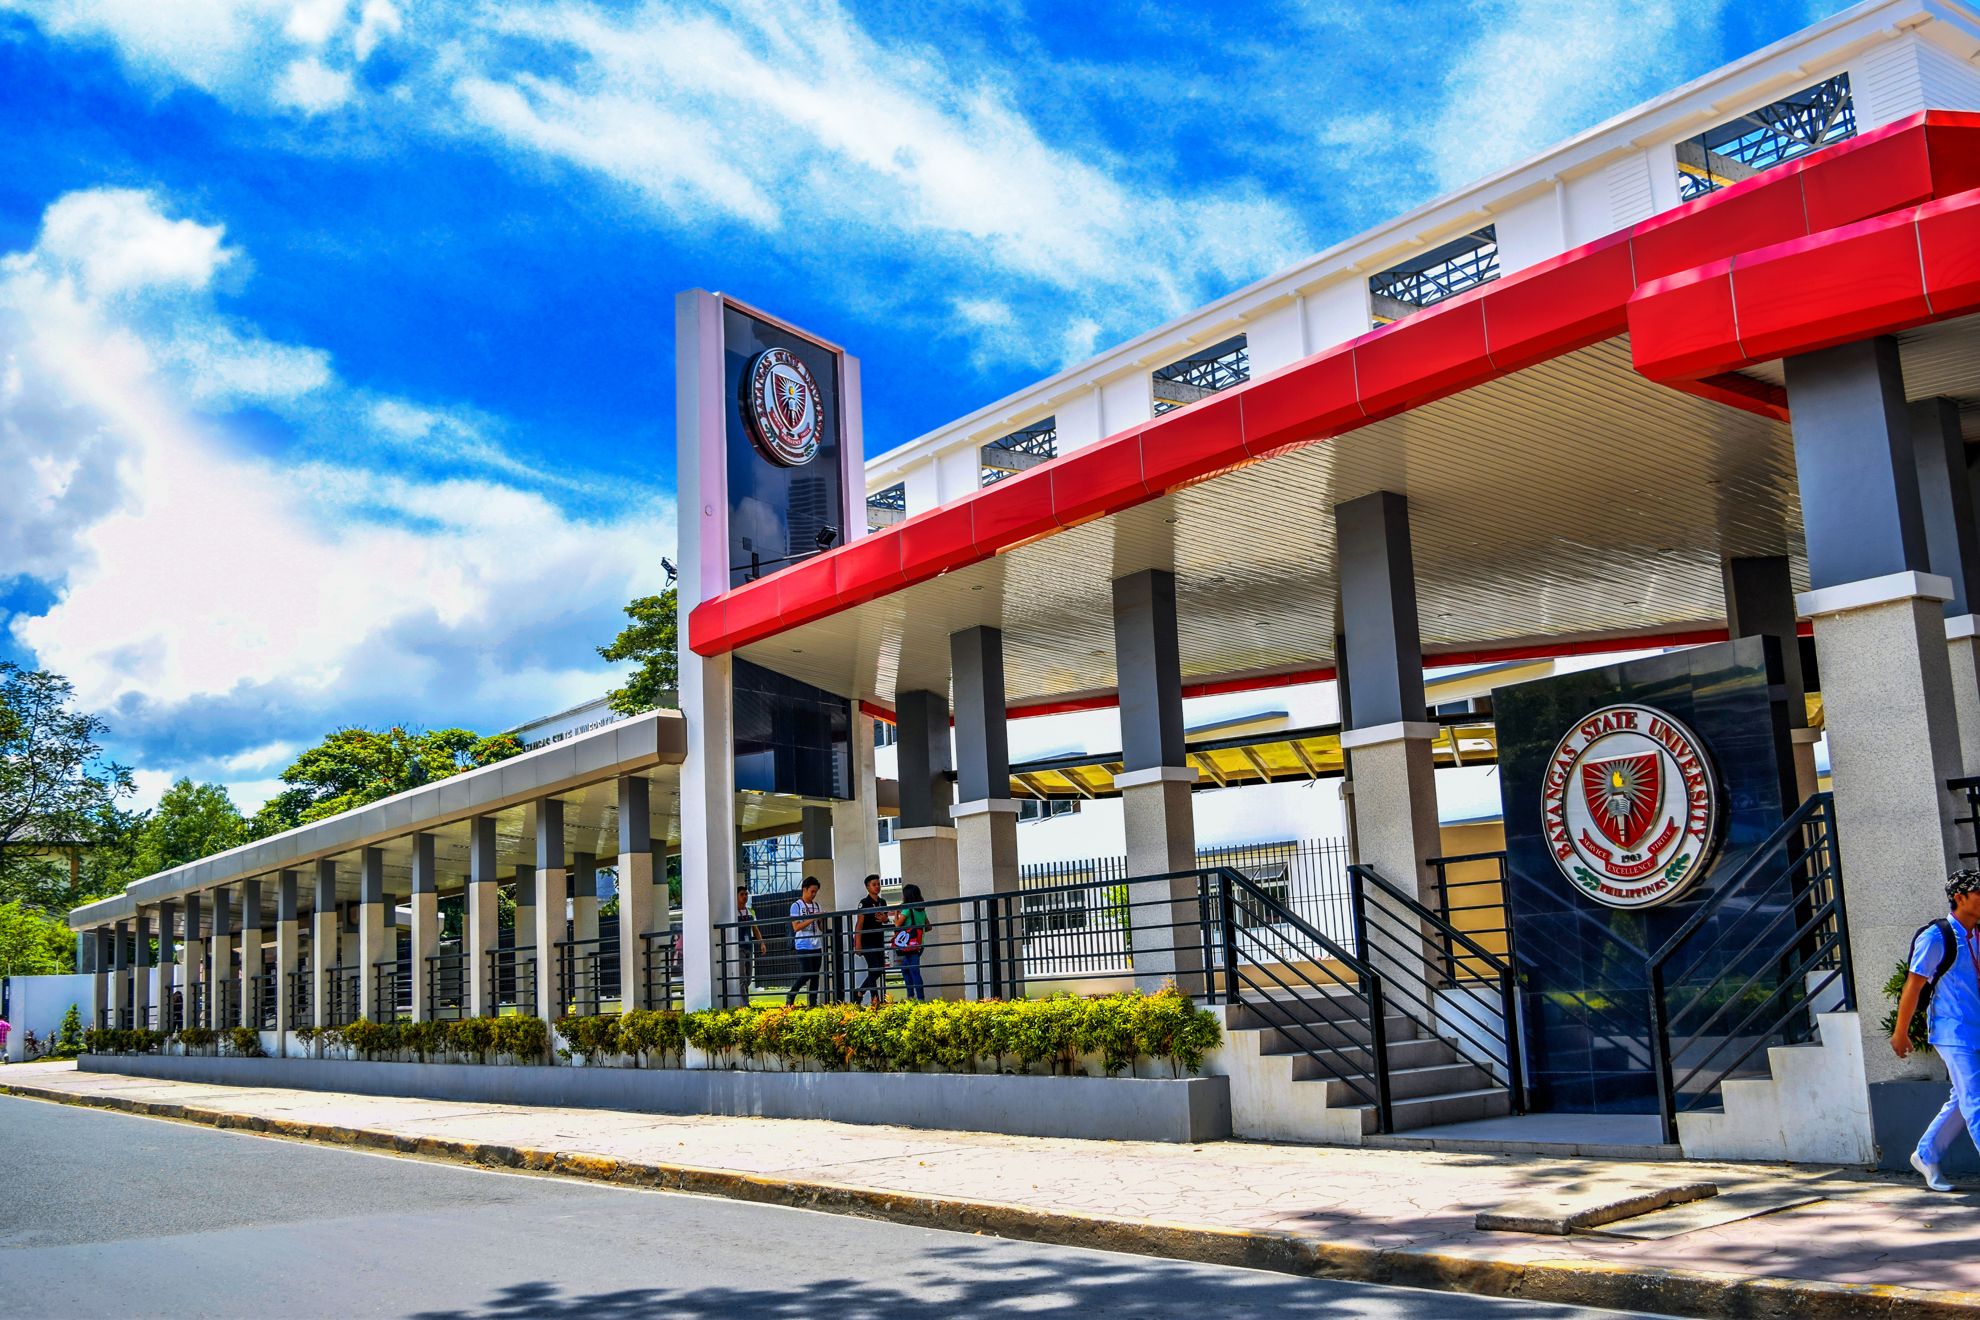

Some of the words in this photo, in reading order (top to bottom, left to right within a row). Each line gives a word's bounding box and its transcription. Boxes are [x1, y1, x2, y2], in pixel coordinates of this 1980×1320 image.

[775, 352, 800, 368] STATE
[1545, 744, 1578, 861] BATANGAS
[1581, 711, 1638, 743] STATE
[1648, 717, 1708, 843] UNIVERSITY
[1584, 838, 1608, 860] SERVICE
[1651, 830, 1672, 851] VIRTUE
[1606, 860, 1653, 875] EXCELLENCE
[1621, 853, 1642, 863] 1903
[1599, 878, 1669, 898] PHILIPPINES
